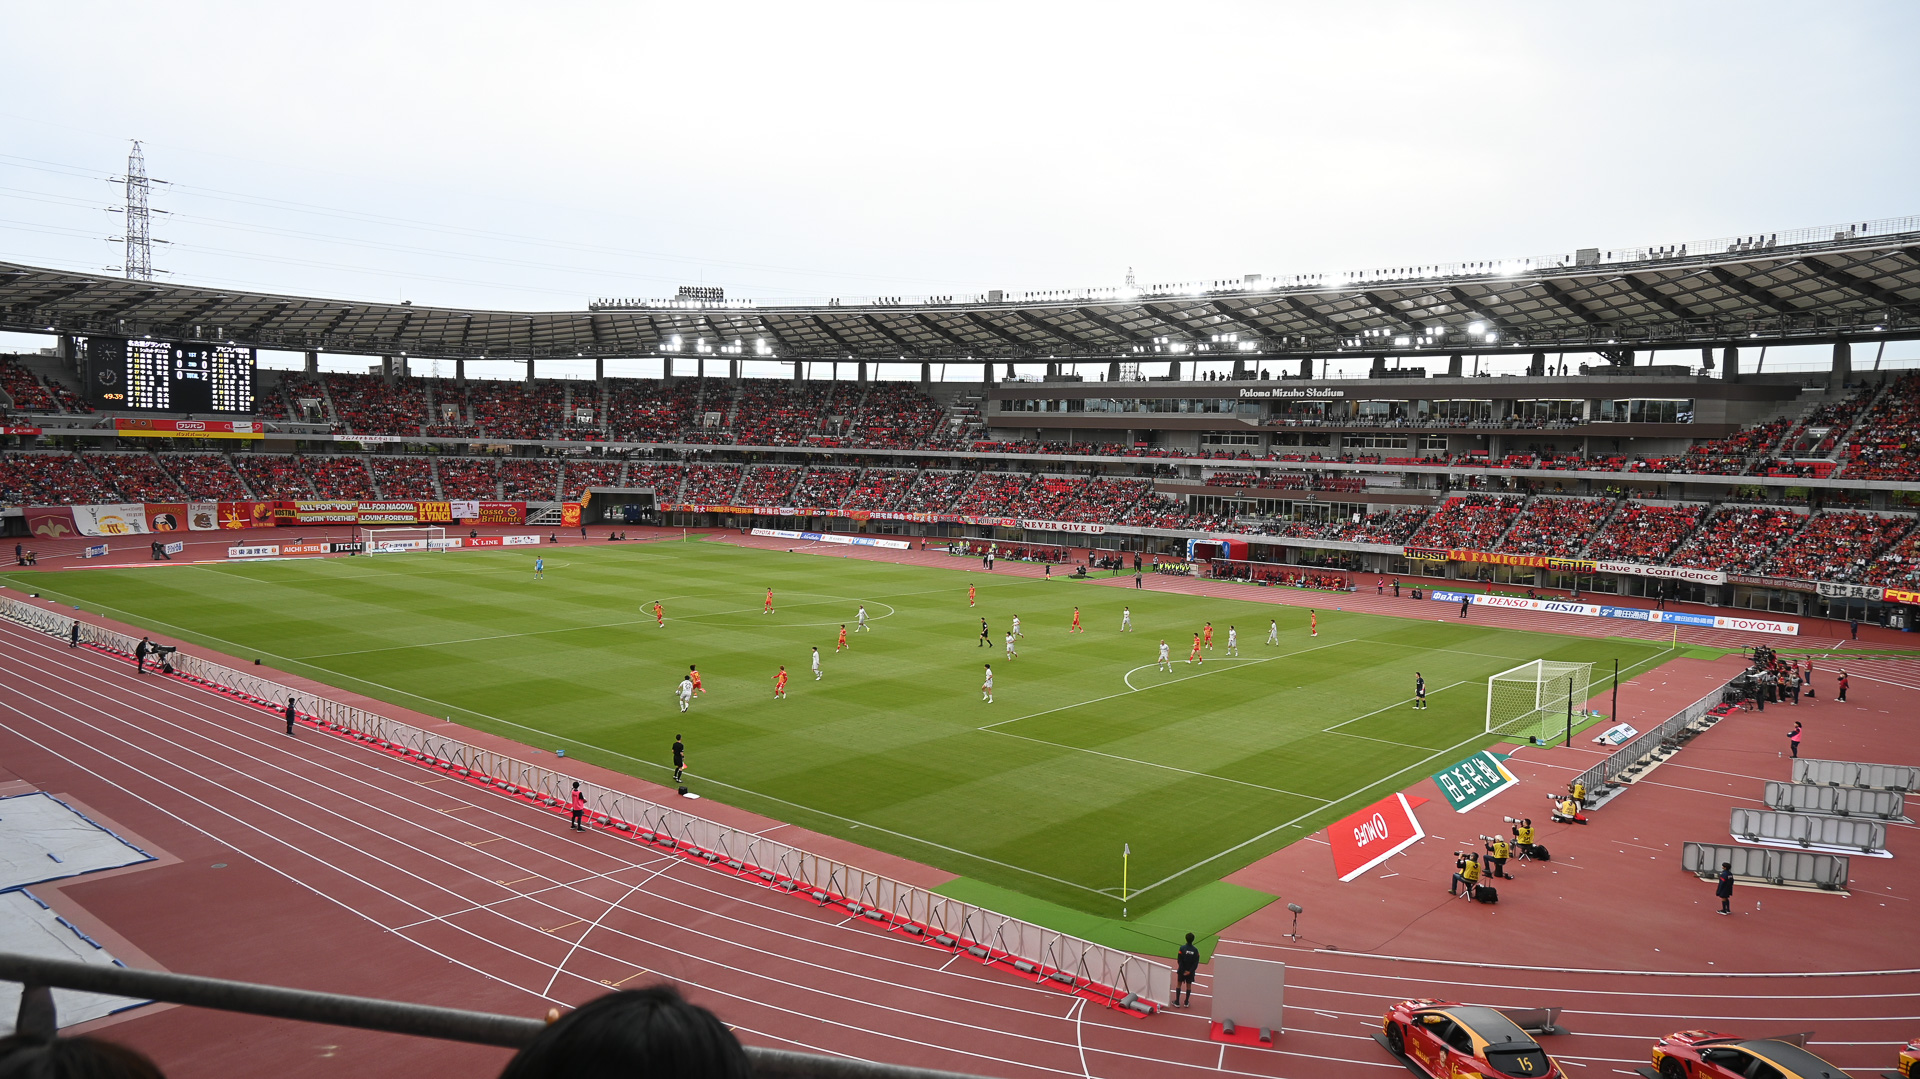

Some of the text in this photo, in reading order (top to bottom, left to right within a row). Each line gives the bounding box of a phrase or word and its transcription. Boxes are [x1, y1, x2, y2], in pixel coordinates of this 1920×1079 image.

[176, 350, 182, 358] 0
[202, 351, 207, 359] 2
[176, 360, 182, 368] 0
[202, 361, 208, 369] 0
[177, 371, 183, 379] 0
[202, 372, 208, 381] 2
[1240, 388, 1344, 397] Paloma Mizuho Stadium
[419, 503, 450, 512] LOTTA
[420, 512, 450, 520] E VINCI
[1450, 550, 1544, 567] LA FAMIGLIA
[1600, 563, 1630, 572] Have
[1646, 567, 1718, 581] Confidence
[1820, 583, 1881, 600] 聖地瑞穂
[1488, 597, 1528, 607] DENSO
[1545, 603, 1584, 612] AISIN
[1732, 620, 1782, 632] TOYOTA
[1354, 820, 1378, 848] MUFG
[1517, 1057, 1533, 1071] 15
